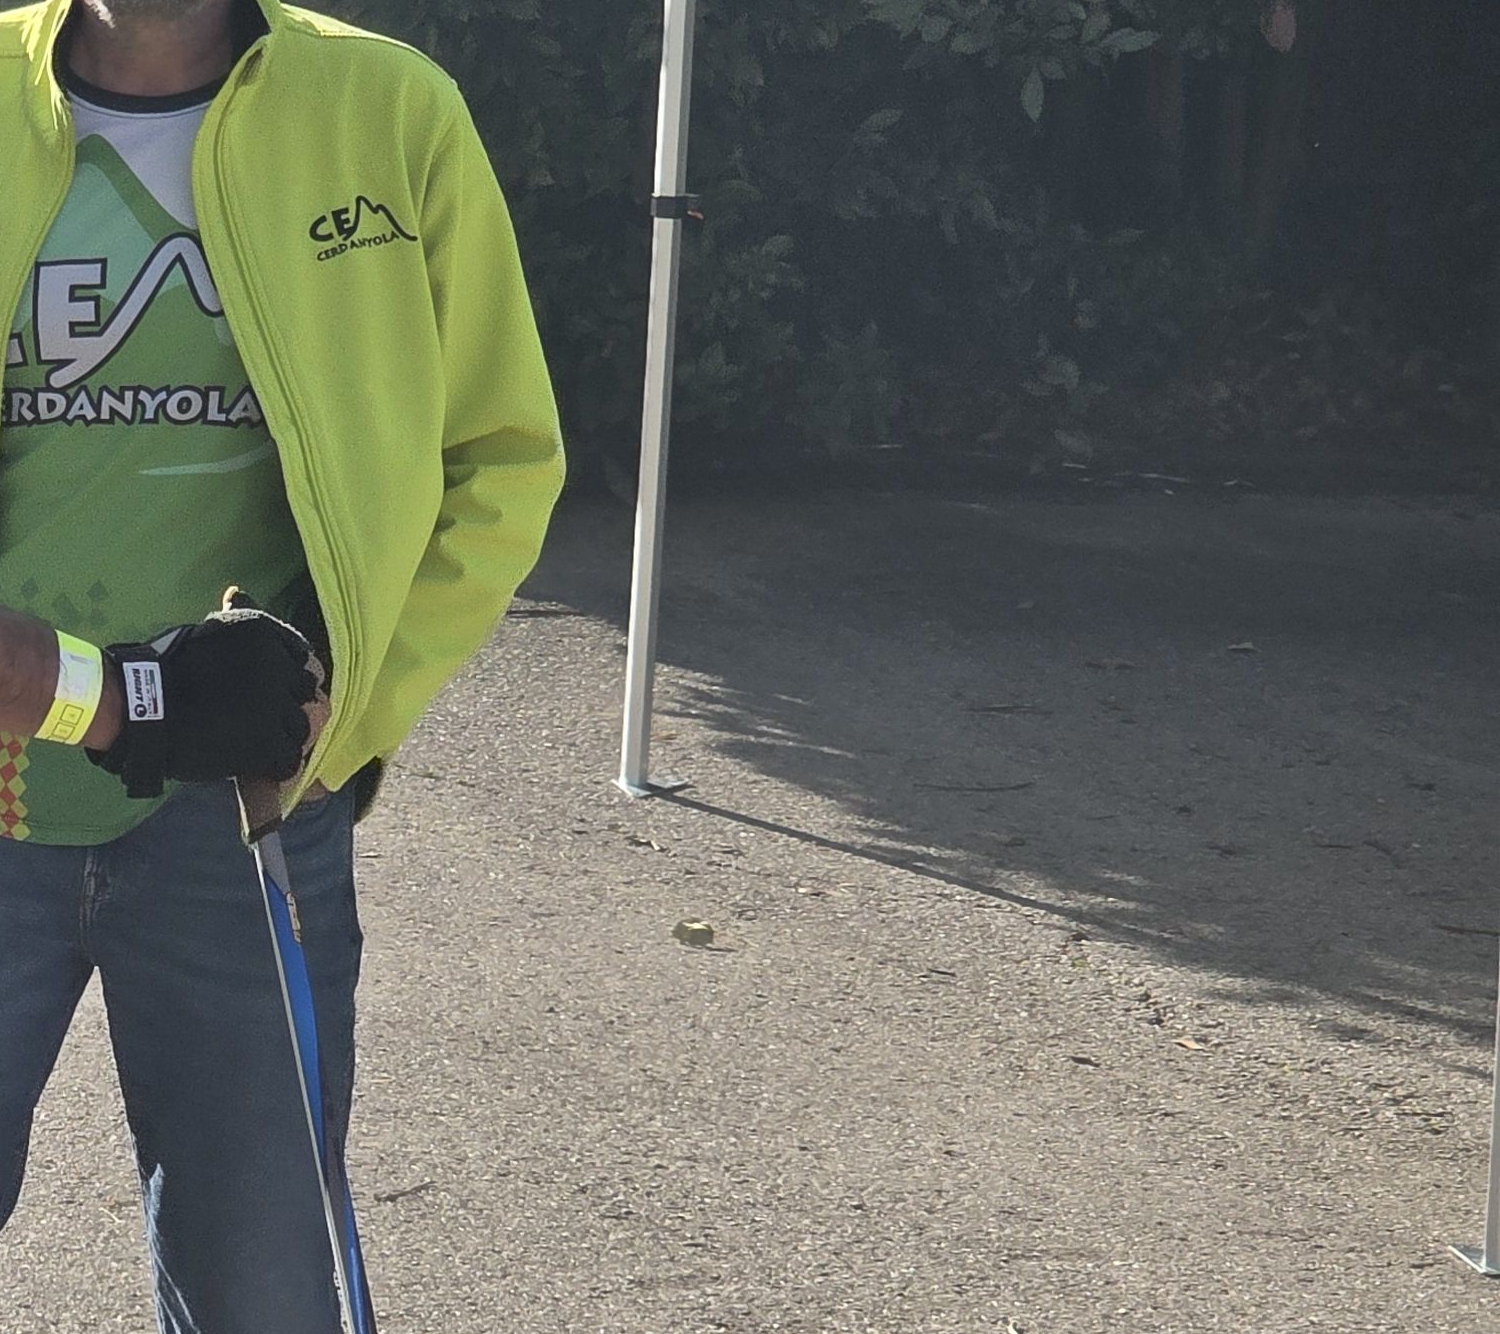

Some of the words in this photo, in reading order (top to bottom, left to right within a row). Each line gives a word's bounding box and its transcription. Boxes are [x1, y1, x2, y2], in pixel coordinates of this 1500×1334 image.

[309, 195, 418, 242] CEM
[317, 230, 400, 261] CERDANYOLA
[0, 386, 264, 426] RDANYOLA
